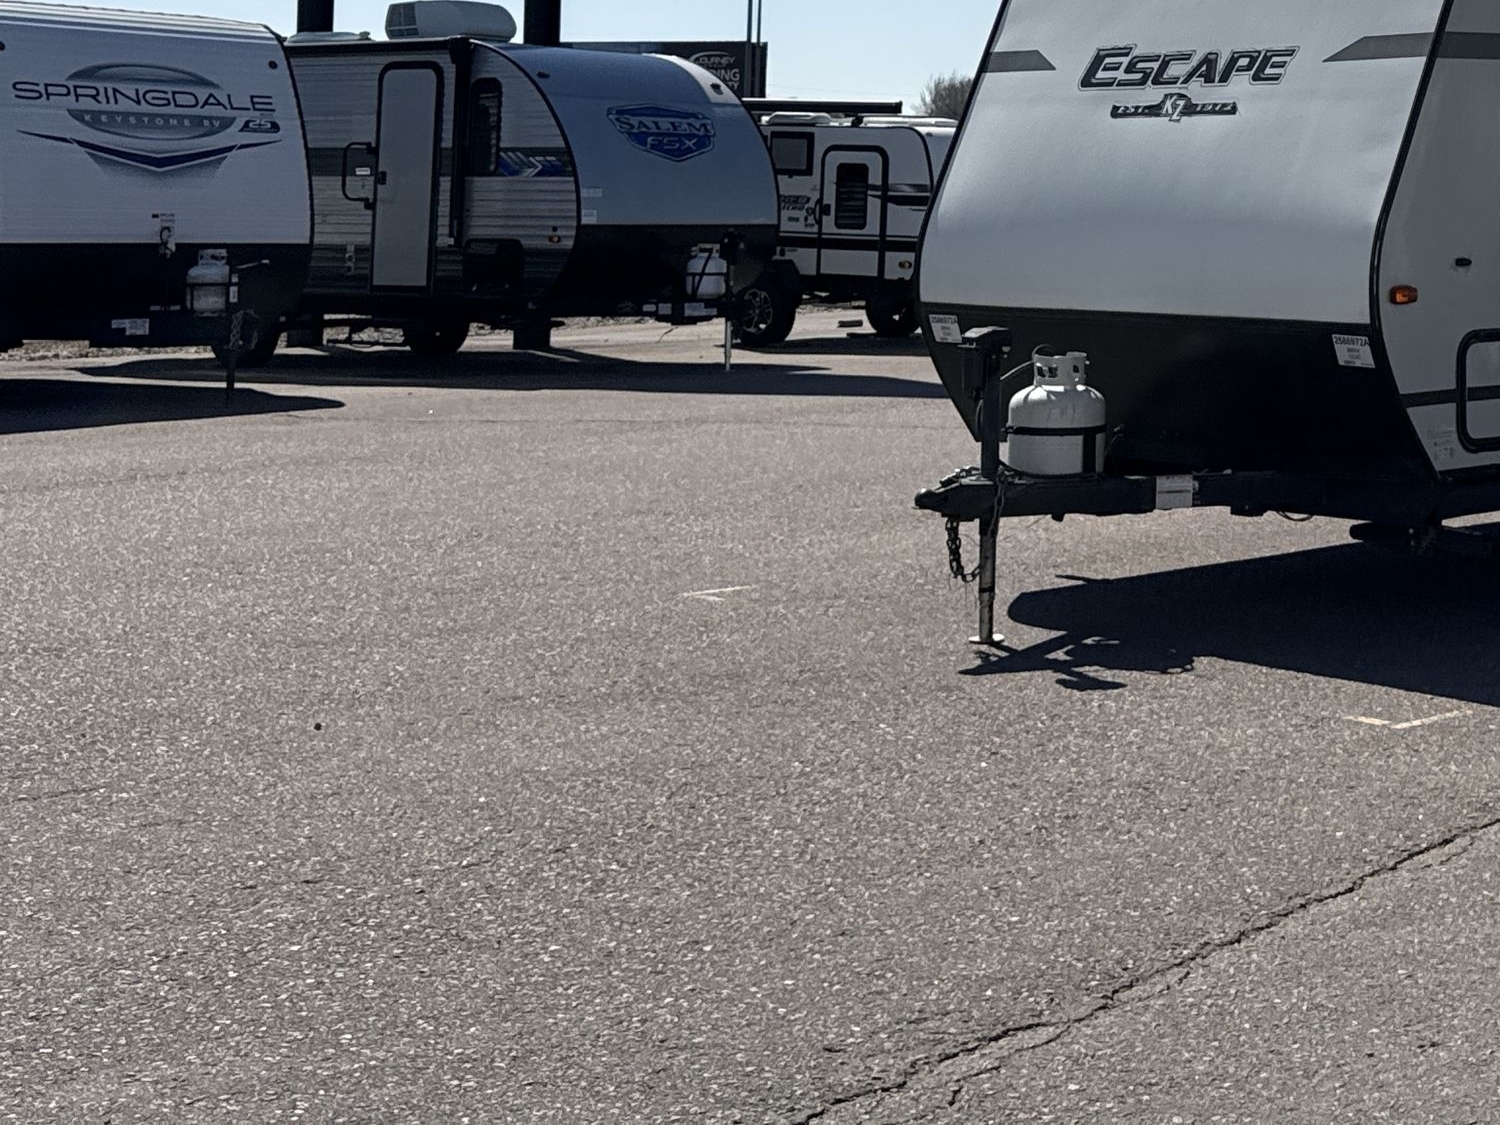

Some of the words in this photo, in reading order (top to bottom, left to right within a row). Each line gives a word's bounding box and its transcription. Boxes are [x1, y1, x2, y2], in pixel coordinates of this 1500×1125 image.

[1079, 44, 1300, 90] ESCAPE
[12, 81, 276, 112] SPRINGDALE
[83, 114, 191, 126] KEYSTONE
[203, 119, 221, 127] RV
[615, 116, 711, 133] SALEM
[647, 136, 697, 150] FSX
